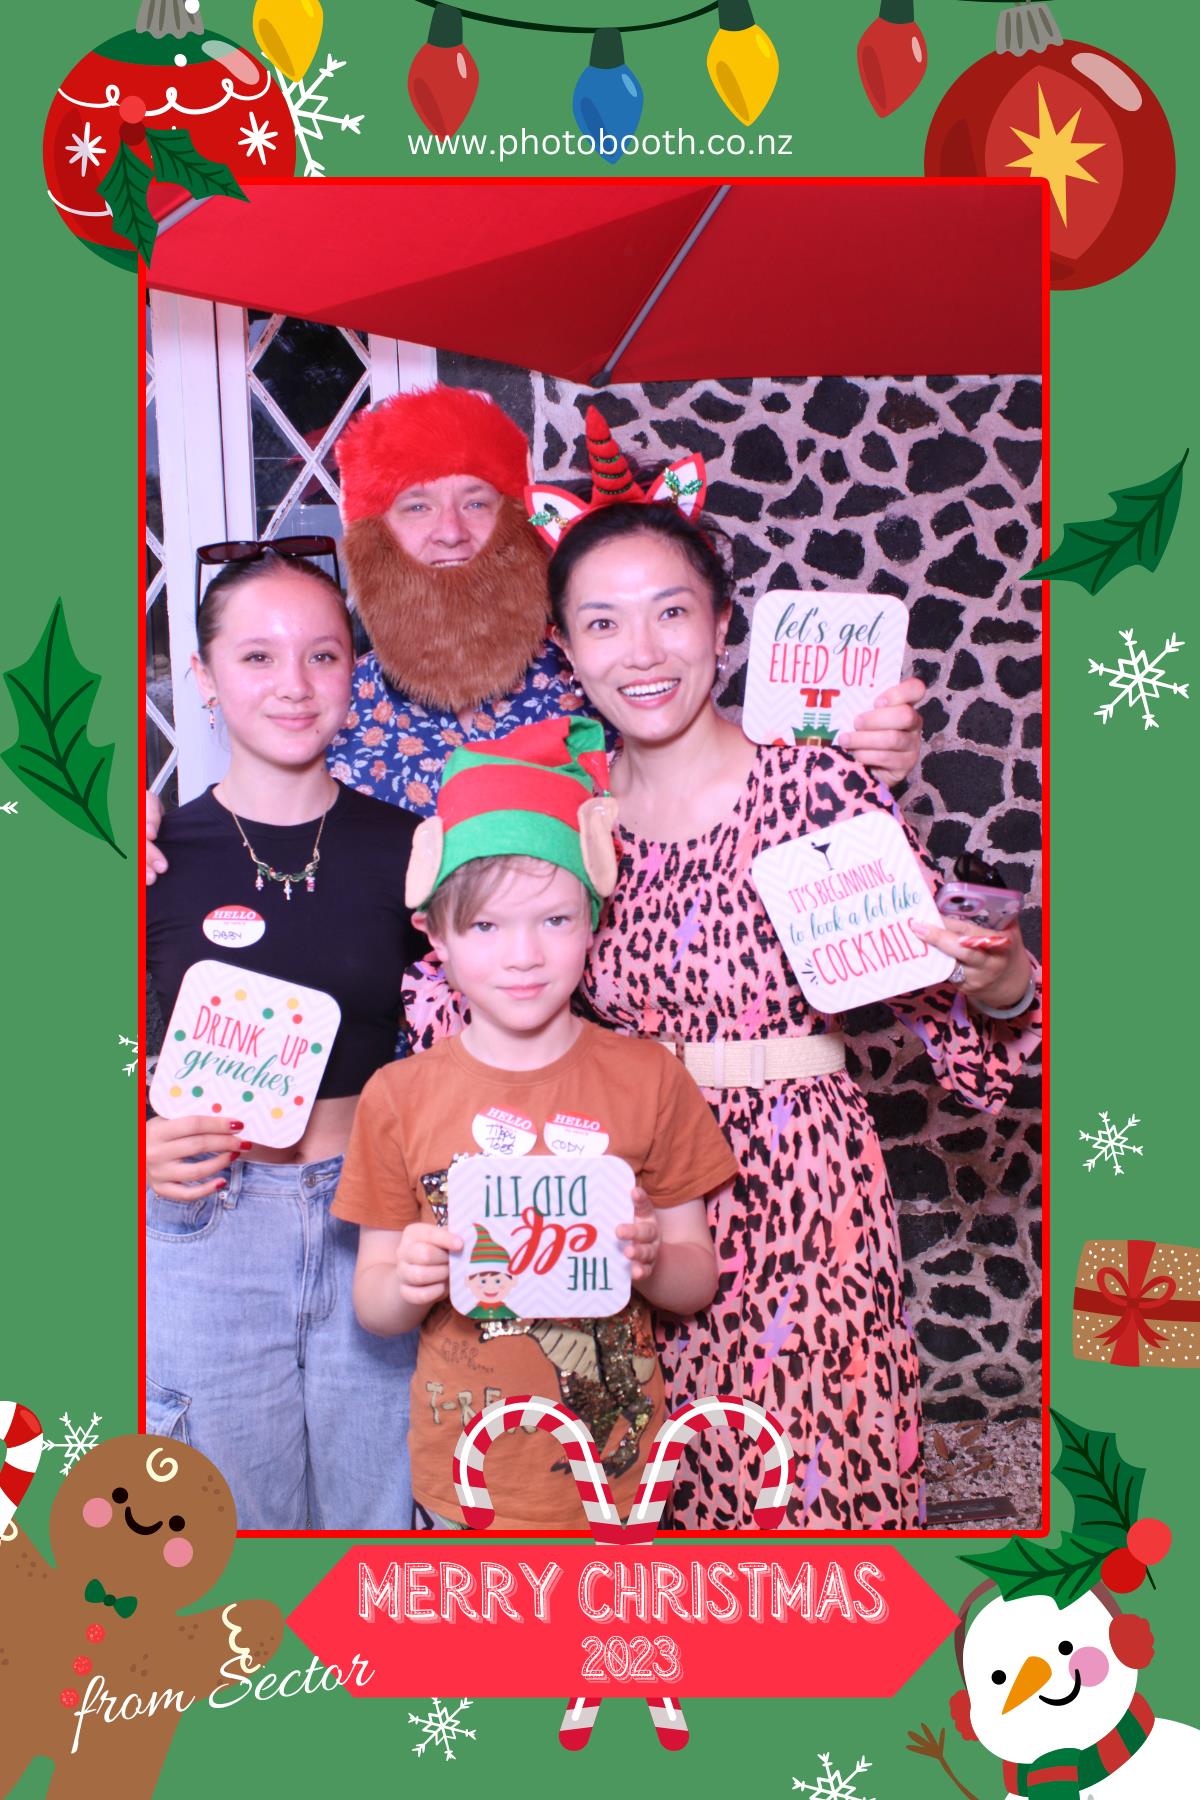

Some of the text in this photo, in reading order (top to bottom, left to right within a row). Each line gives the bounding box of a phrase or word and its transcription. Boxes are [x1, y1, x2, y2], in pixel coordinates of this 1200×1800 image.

[774, 602, 885, 655] let's get
[769, 643, 880, 688] ELFED UP!
[788, 858, 895, 914] IT'S BEGINNING
[213, 910, 257, 920] HELLO
[789, 882, 921, 946] to look a lot like
[192, 1005, 309, 1069] DRINK UP
[175, 1049, 295, 1096] grinches
[486, 1106, 532, 1130] HELLO
[553, 1113, 600, 1131] HELLO
[484, 1174, 587, 1217] DID IT!
[507, 1206, 598, 1275] elf
[567, 1256, 613, 1291] THE
